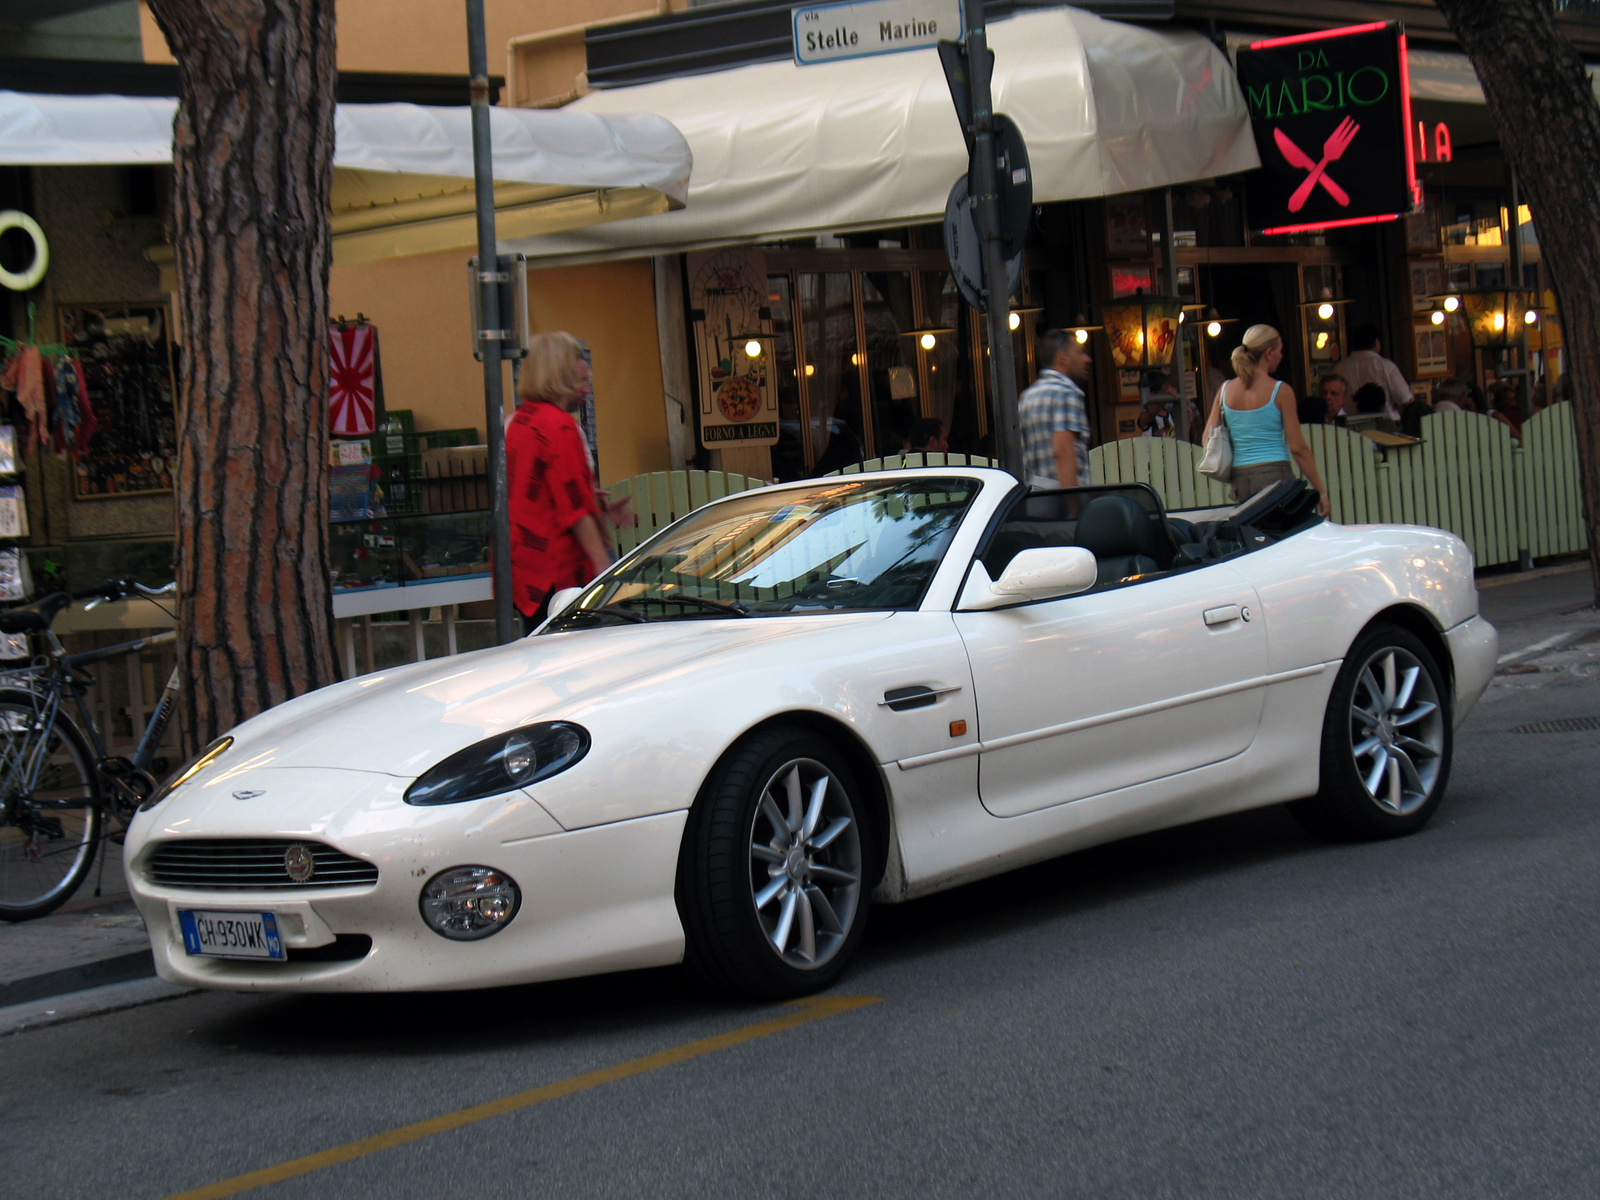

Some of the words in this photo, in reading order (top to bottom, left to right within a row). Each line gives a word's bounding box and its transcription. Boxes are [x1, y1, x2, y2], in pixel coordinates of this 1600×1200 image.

[804, 11, 819, 21] via
[806, 26, 859, 51] Stelle
[879, 18, 937, 41] Marine
[1297, 48, 1329, 71] DA
[1247, 65, 1389, 120] MARIO
[704, 426, 735, 441] FORNO
[738, 427, 744, 439] A
[747, 423, 776, 438] LEGNA
